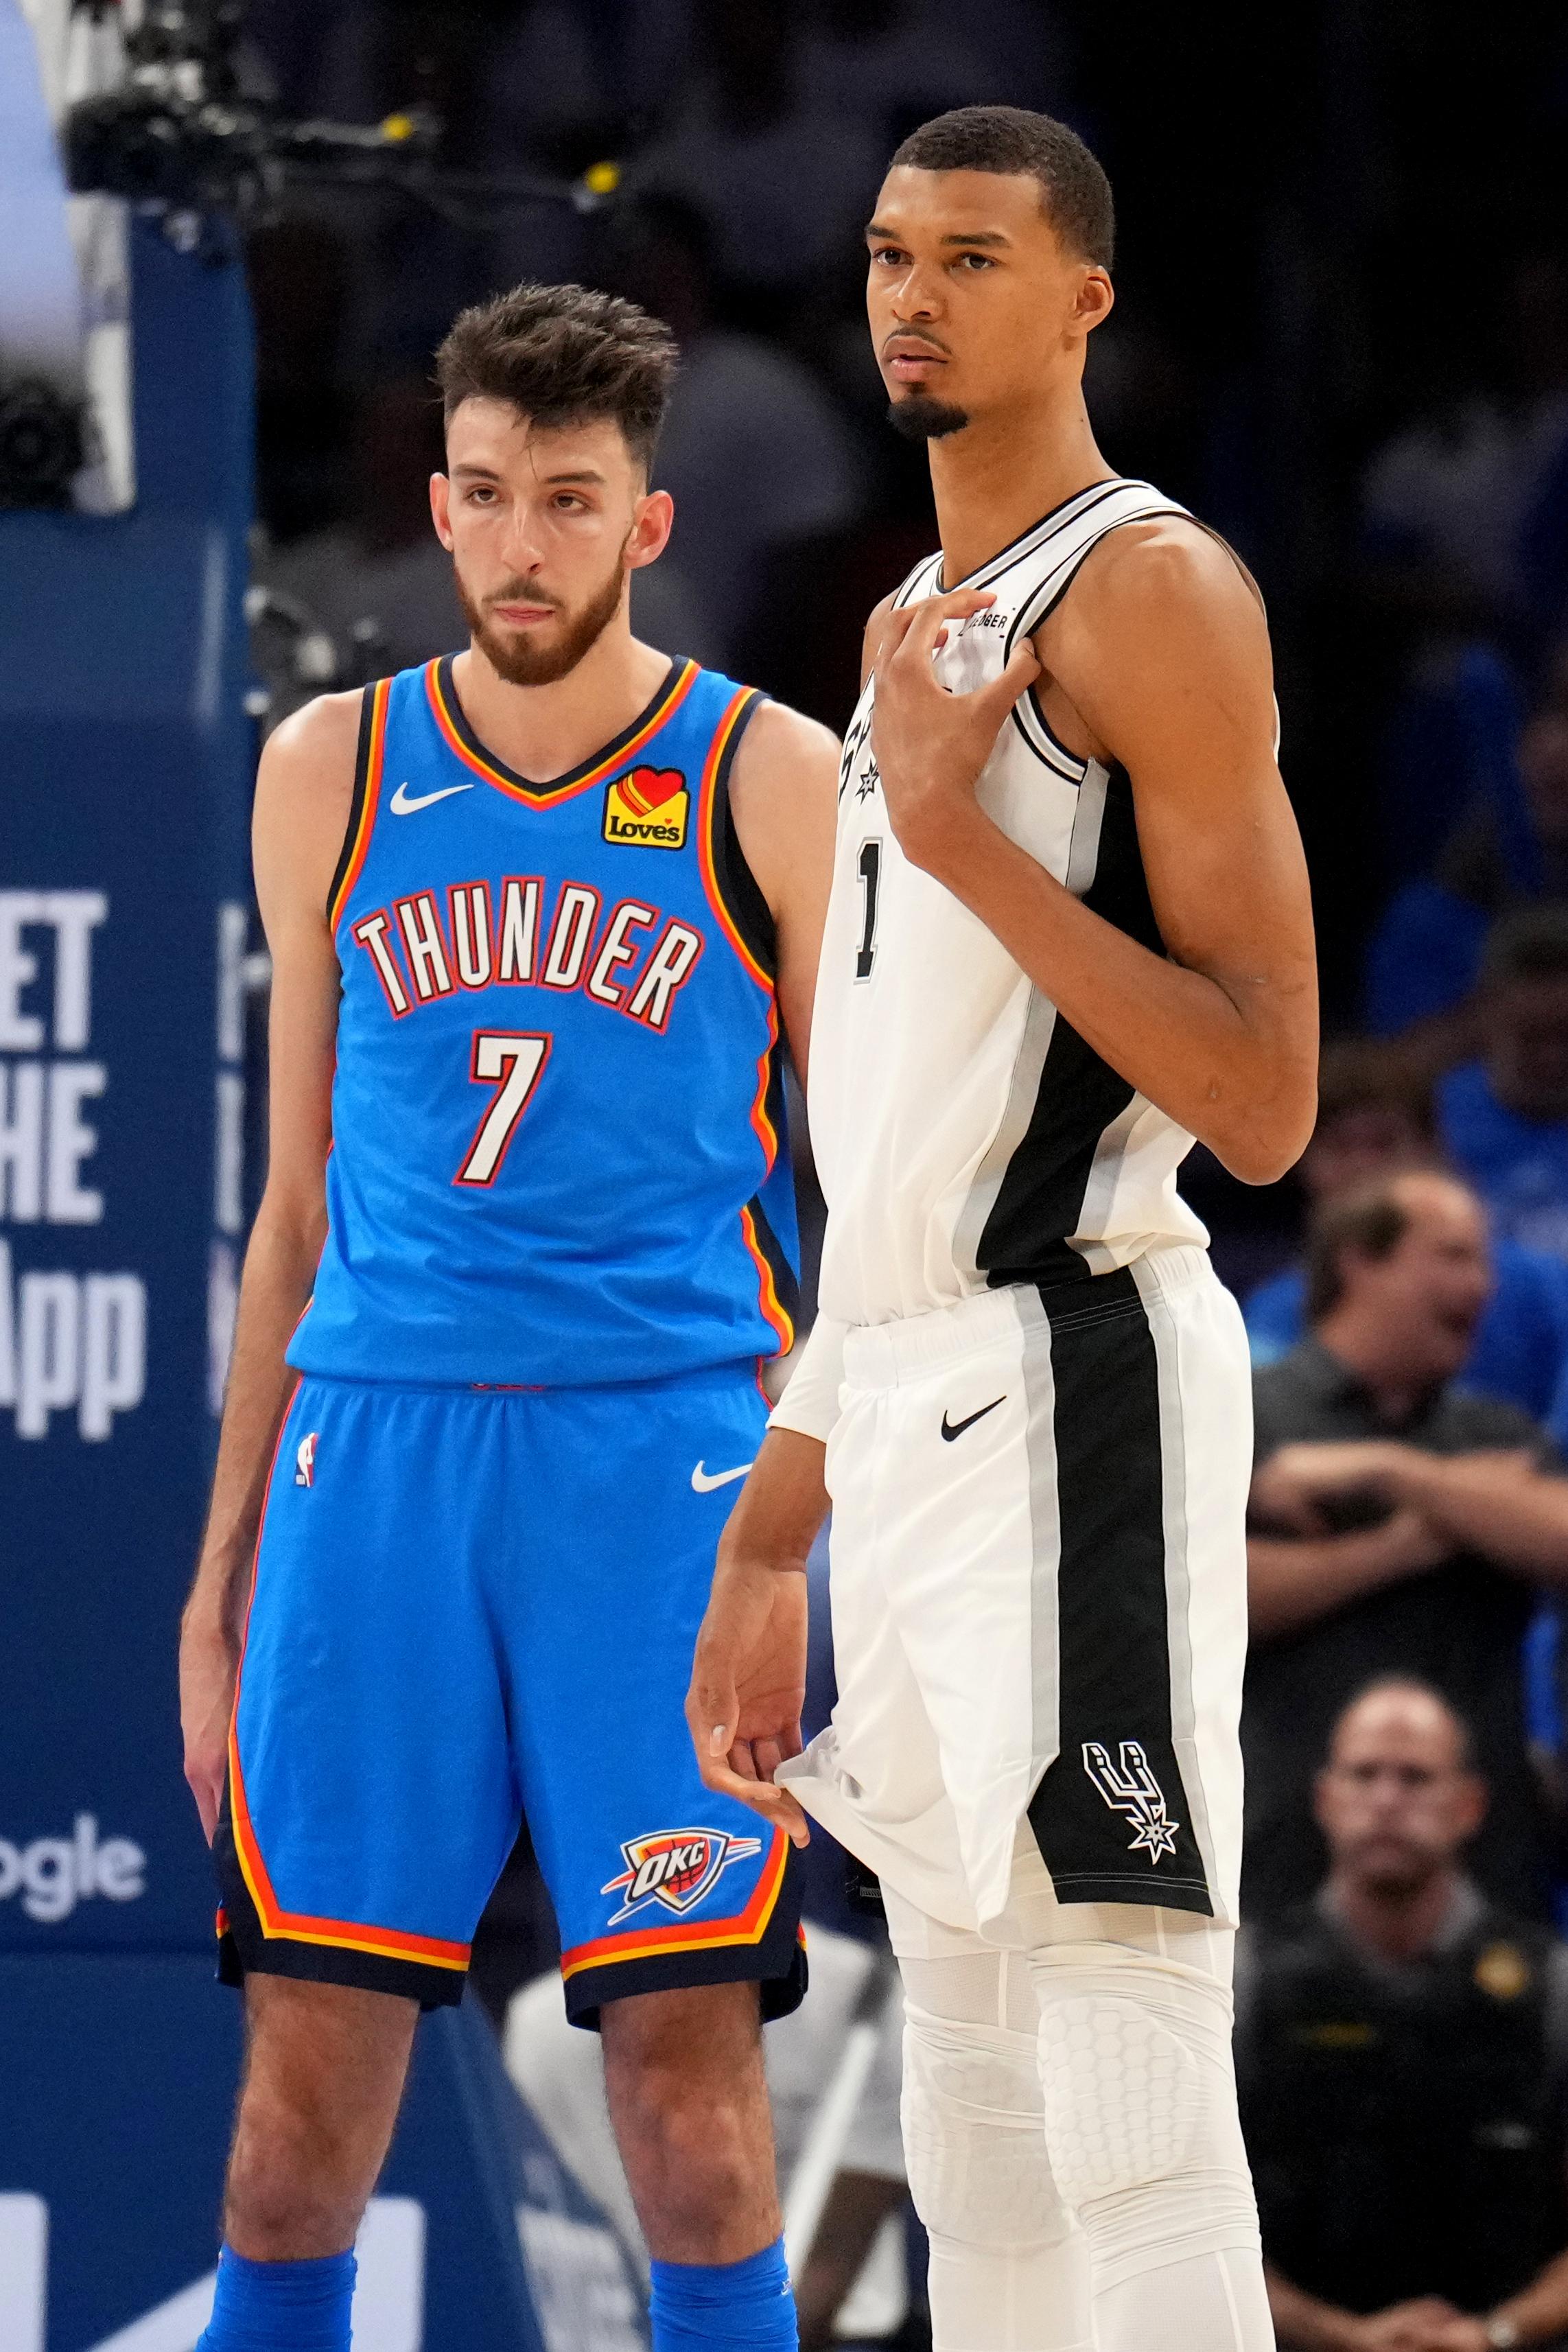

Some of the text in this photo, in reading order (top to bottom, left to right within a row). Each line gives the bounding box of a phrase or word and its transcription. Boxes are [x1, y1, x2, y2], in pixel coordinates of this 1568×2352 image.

[968, 614, 1008, 629] EDGER
[352, 876, 705, 1035] THUNDER
[854, 837, 882, 985] 1
[452, 1029, 552, 1188] 7
[629, 1841, 706, 1900] OKC
